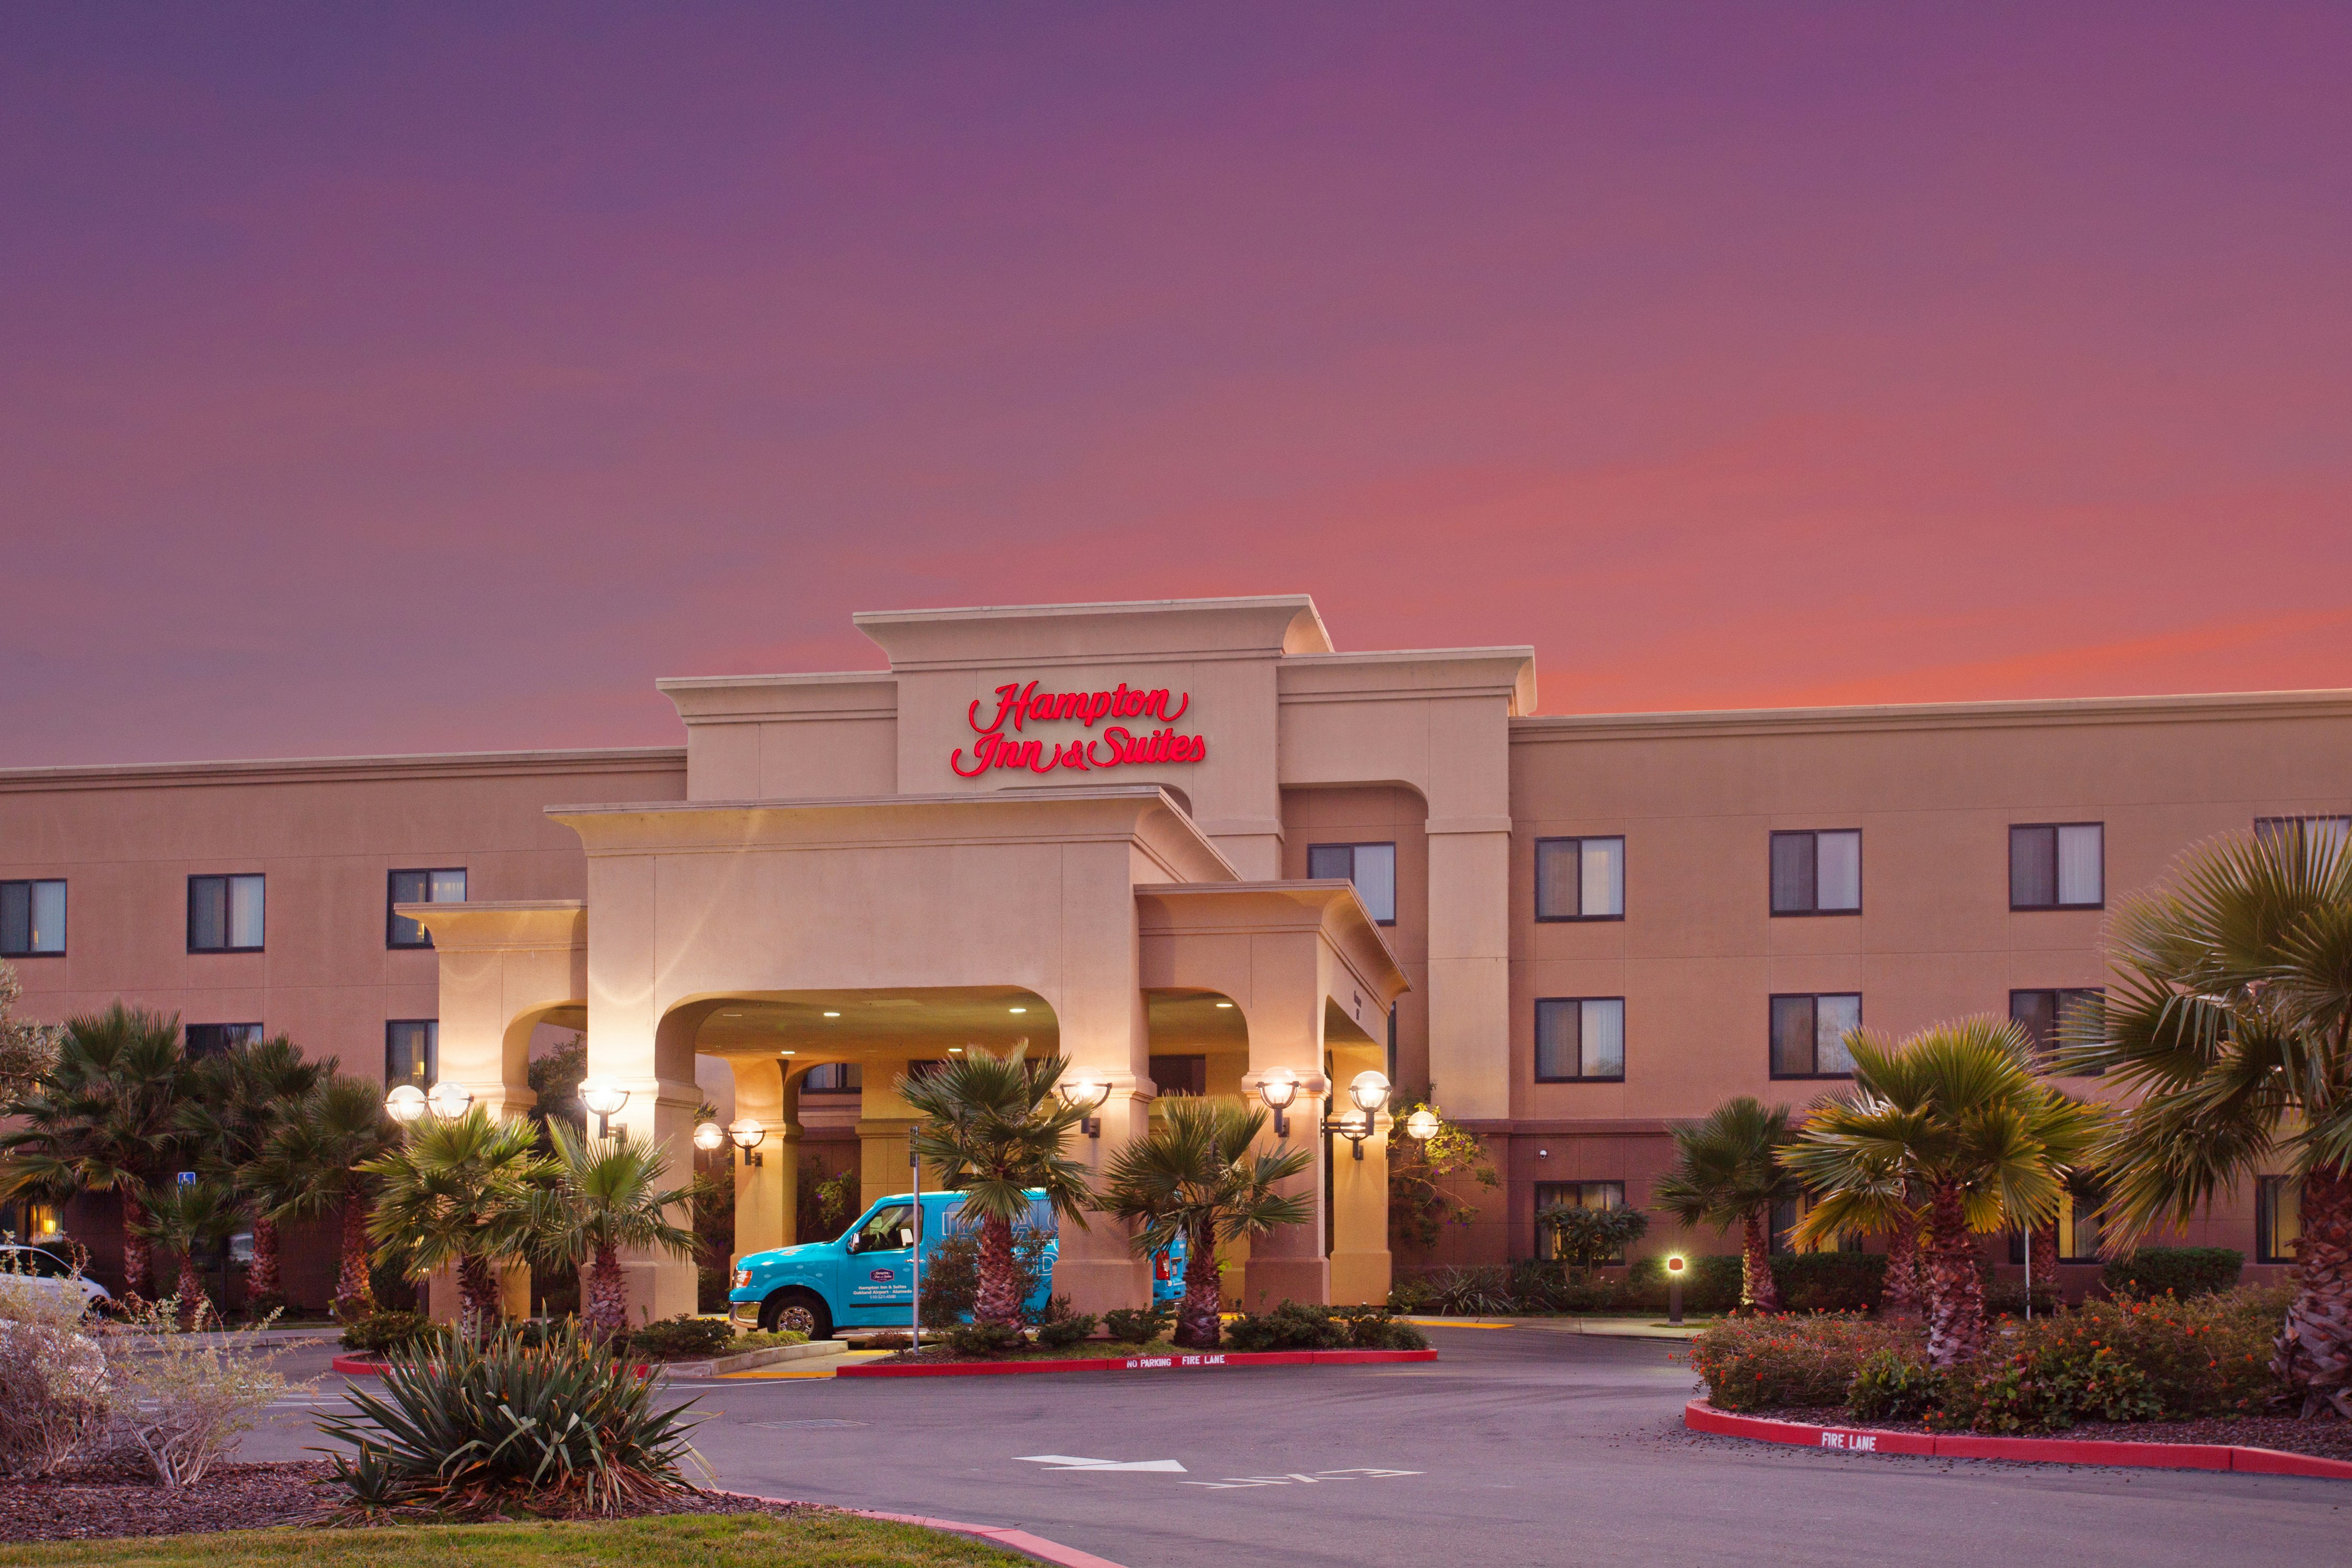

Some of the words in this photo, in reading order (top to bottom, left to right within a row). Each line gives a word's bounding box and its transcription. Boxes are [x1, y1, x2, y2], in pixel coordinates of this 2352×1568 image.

[969, 681, 1188, 734] Hampton
[951, 733, 1061, 777] Inn
[1062, 741, 1090, 771] &
[1087, 727, 1205, 767] Suites
[1140, 1358, 1171, 1367] PARKING
[1182, 1356, 1200, 1365] FIRE
[1204, 1355, 1225, 1364] LANE
[1822, 1432, 1844, 1448] FIRE
[1849, 1435, 1876, 1451] LANE
